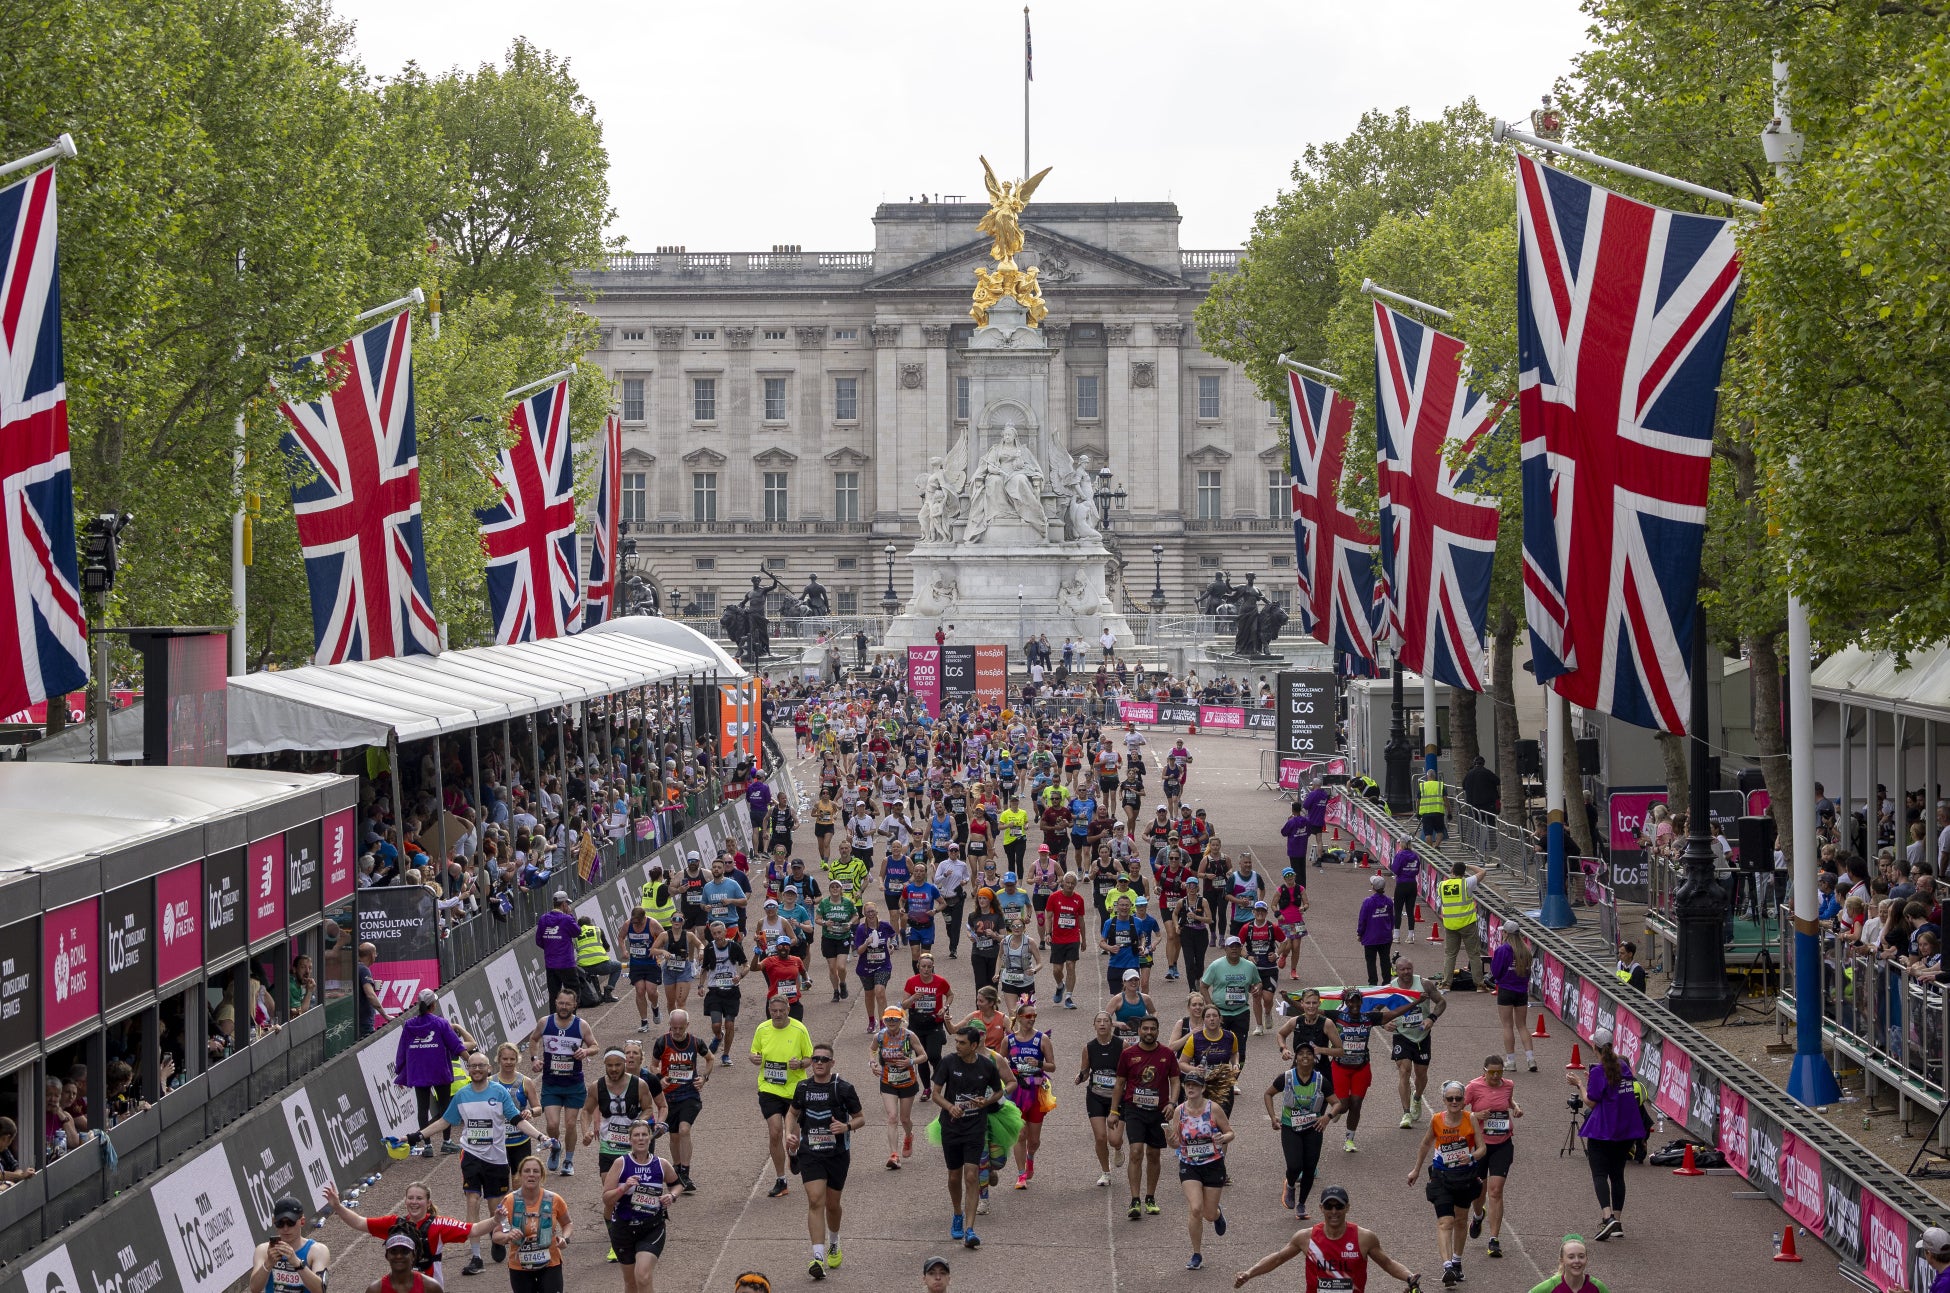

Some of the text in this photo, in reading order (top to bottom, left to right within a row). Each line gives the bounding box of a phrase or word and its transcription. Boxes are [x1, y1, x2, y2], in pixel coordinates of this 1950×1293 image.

[909, 651, 923, 659] tcs
[977, 649, 1004, 657] HubSpot
[914, 666, 934, 674] 200
[945, 665, 963, 676] tcs
[977, 669, 1004, 677] HubSpot
[977, 688, 1004, 696] HubSpot
[1292, 699, 1314, 713] tcs
[1292, 736, 1314, 750] tcs
[1618, 811, 1639, 832] tcs
[290, 853, 301, 896] tcs
[1613, 864, 1638, 884] tcs
[174, 900, 188, 919] WORLD
[209, 883, 222, 930] tcs
[359, 910, 387, 920] TATA
[124, 913, 134, 930] TATA
[175, 916, 195, 939] ATHLETICS
[360, 918, 424, 930] CONSULTANCY
[124, 928, 147, 948] CONSULTANCY
[360, 929, 402, 940] SERVICES
[70, 944, 86, 968] ROYAL
[108, 922, 124, 974] tcs
[2, 958, 14, 976] TATA
[125, 949, 140, 968] SERVICES
[2, 973, 30, 998] CONSULTANCY
[70, 970, 86, 996] PARKS
[914, 986, 937, 994] CHARLIE
[2, 998, 20, 1020] SERVICES
[669, 1052, 693, 1062] ANDY
[373, 1072, 402, 1130] tcs
[468, 1120, 478, 1128] tcs
[322, 1109, 354, 1168] tcs
[308, 1158, 328, 1189] TATA
[195, 1192, 212, 1216] TATA
[242, 1165, 276, 1231] tcs
[204, 1206, 235, 1242] CONSULTANCY
[432, 1217, 468, 1230] ANNABEL
[117, 1244, 138, 1272] TATA
[174, 1213, 214, 1284] tcs
[212, 1238, 234, 1268] SERVICES
[523, 1253, 546, 1262] 67464
[128, 1258, 164, 1293] CONSULTANCY
[1317, 1260, 1352, 1272] NEIL
[276, 1272, 300, 1284] 36639
[1318, 1278, 1332, 1288] tcs
